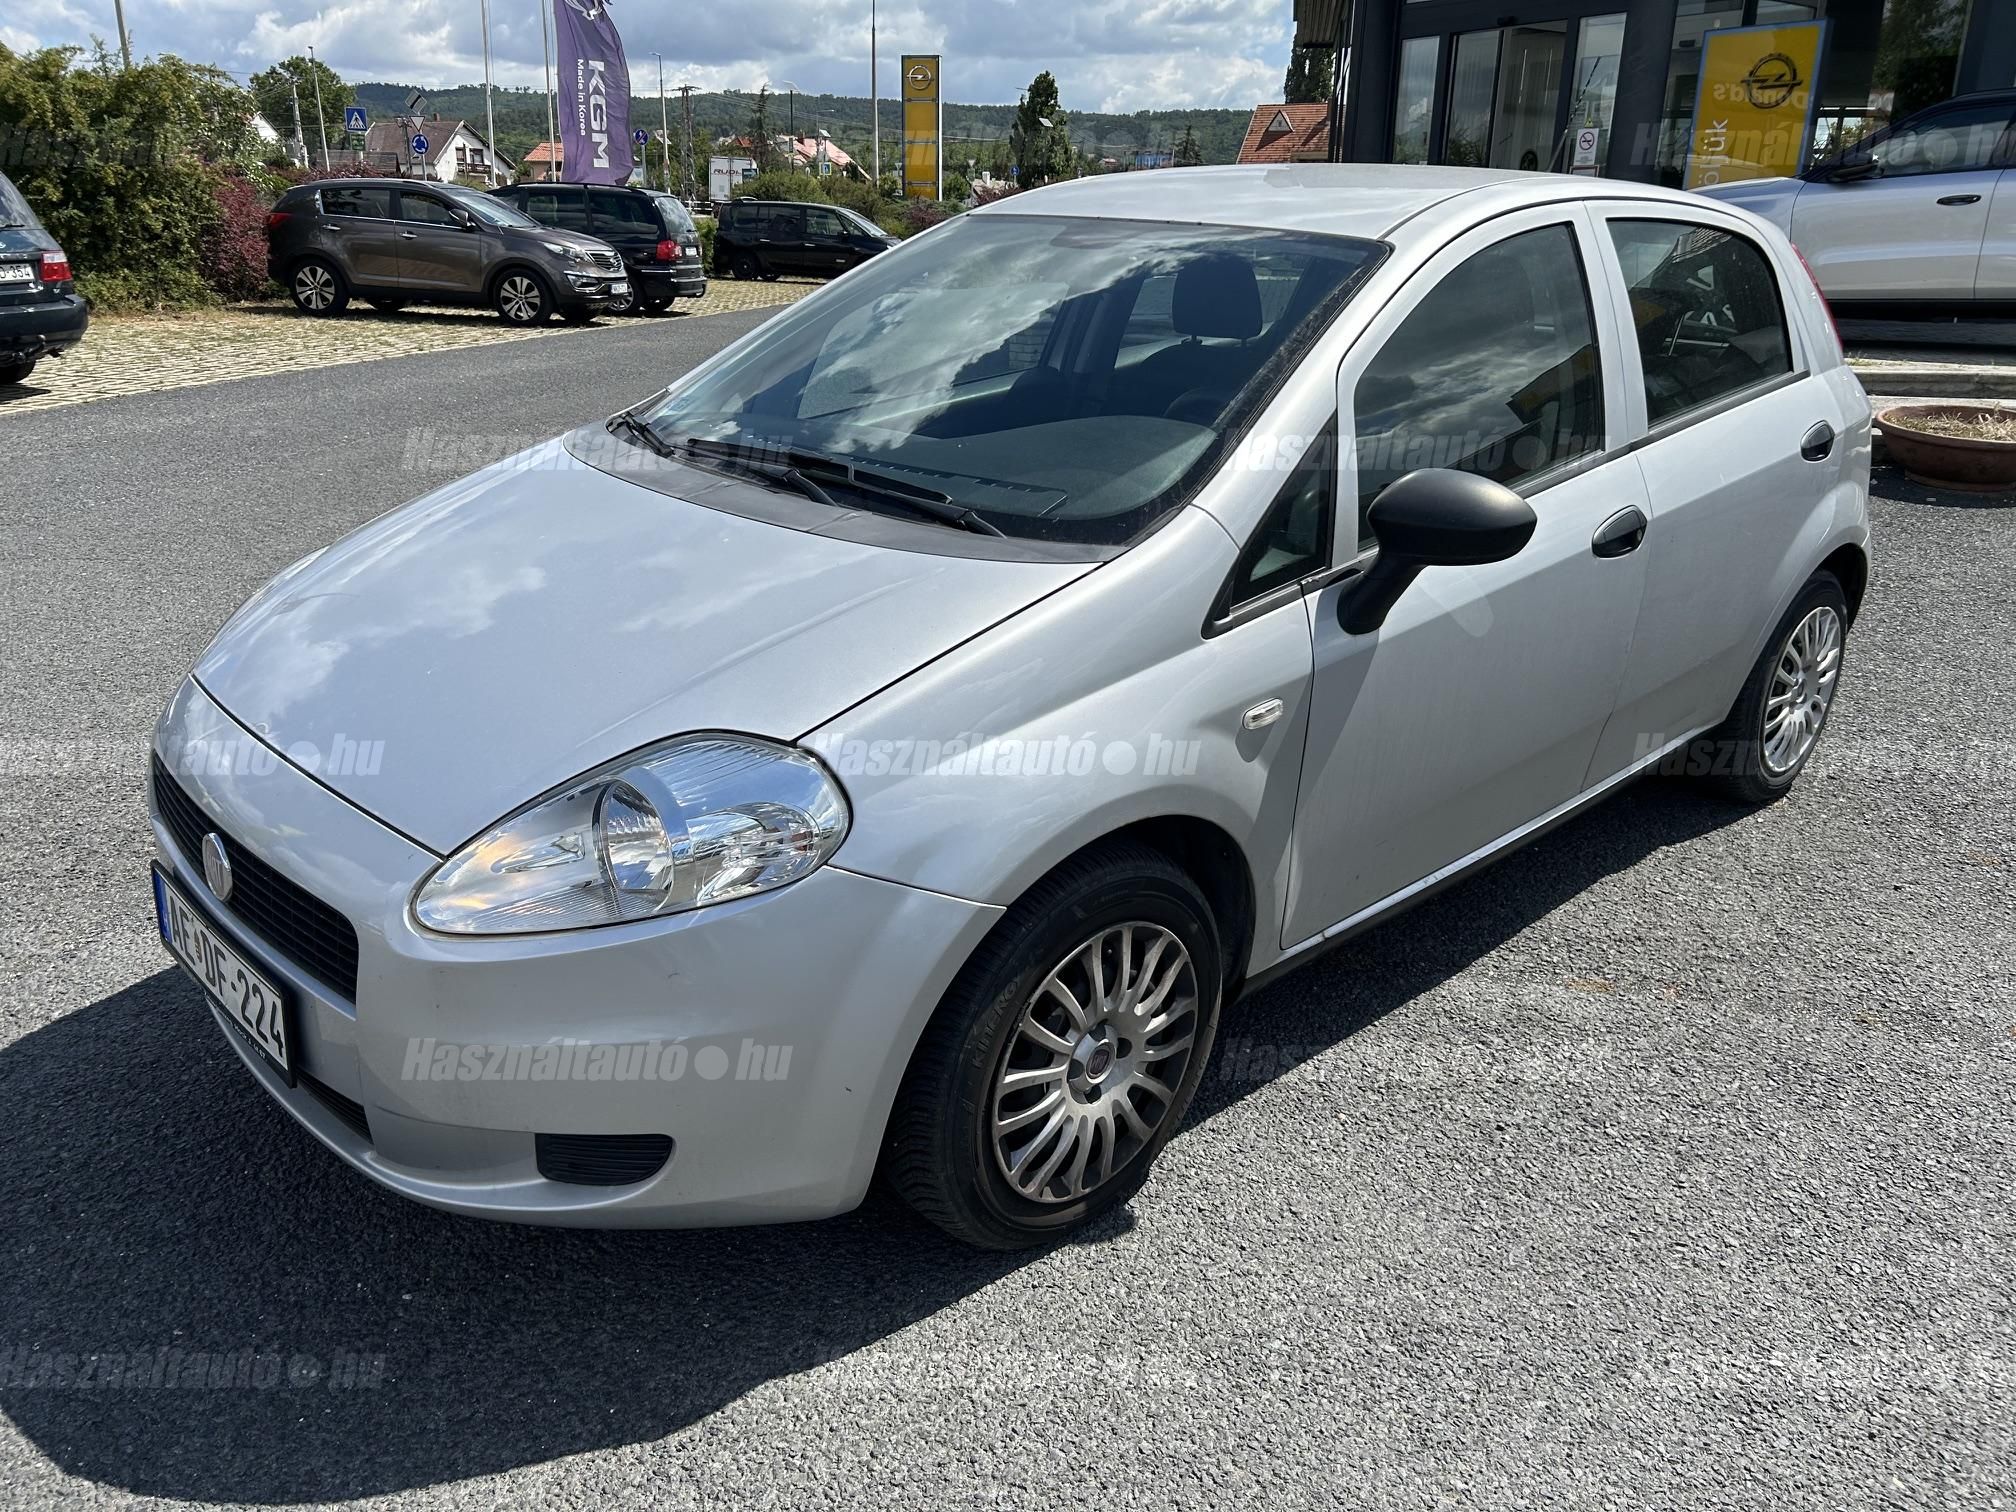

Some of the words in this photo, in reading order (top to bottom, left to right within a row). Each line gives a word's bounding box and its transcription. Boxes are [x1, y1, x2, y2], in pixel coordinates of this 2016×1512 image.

[577, 59, 585, 88] Made
[578, 92, 585, 102] in
[578, 105, 586, 136] Korea
[588, 60, 610, 168] KGM
